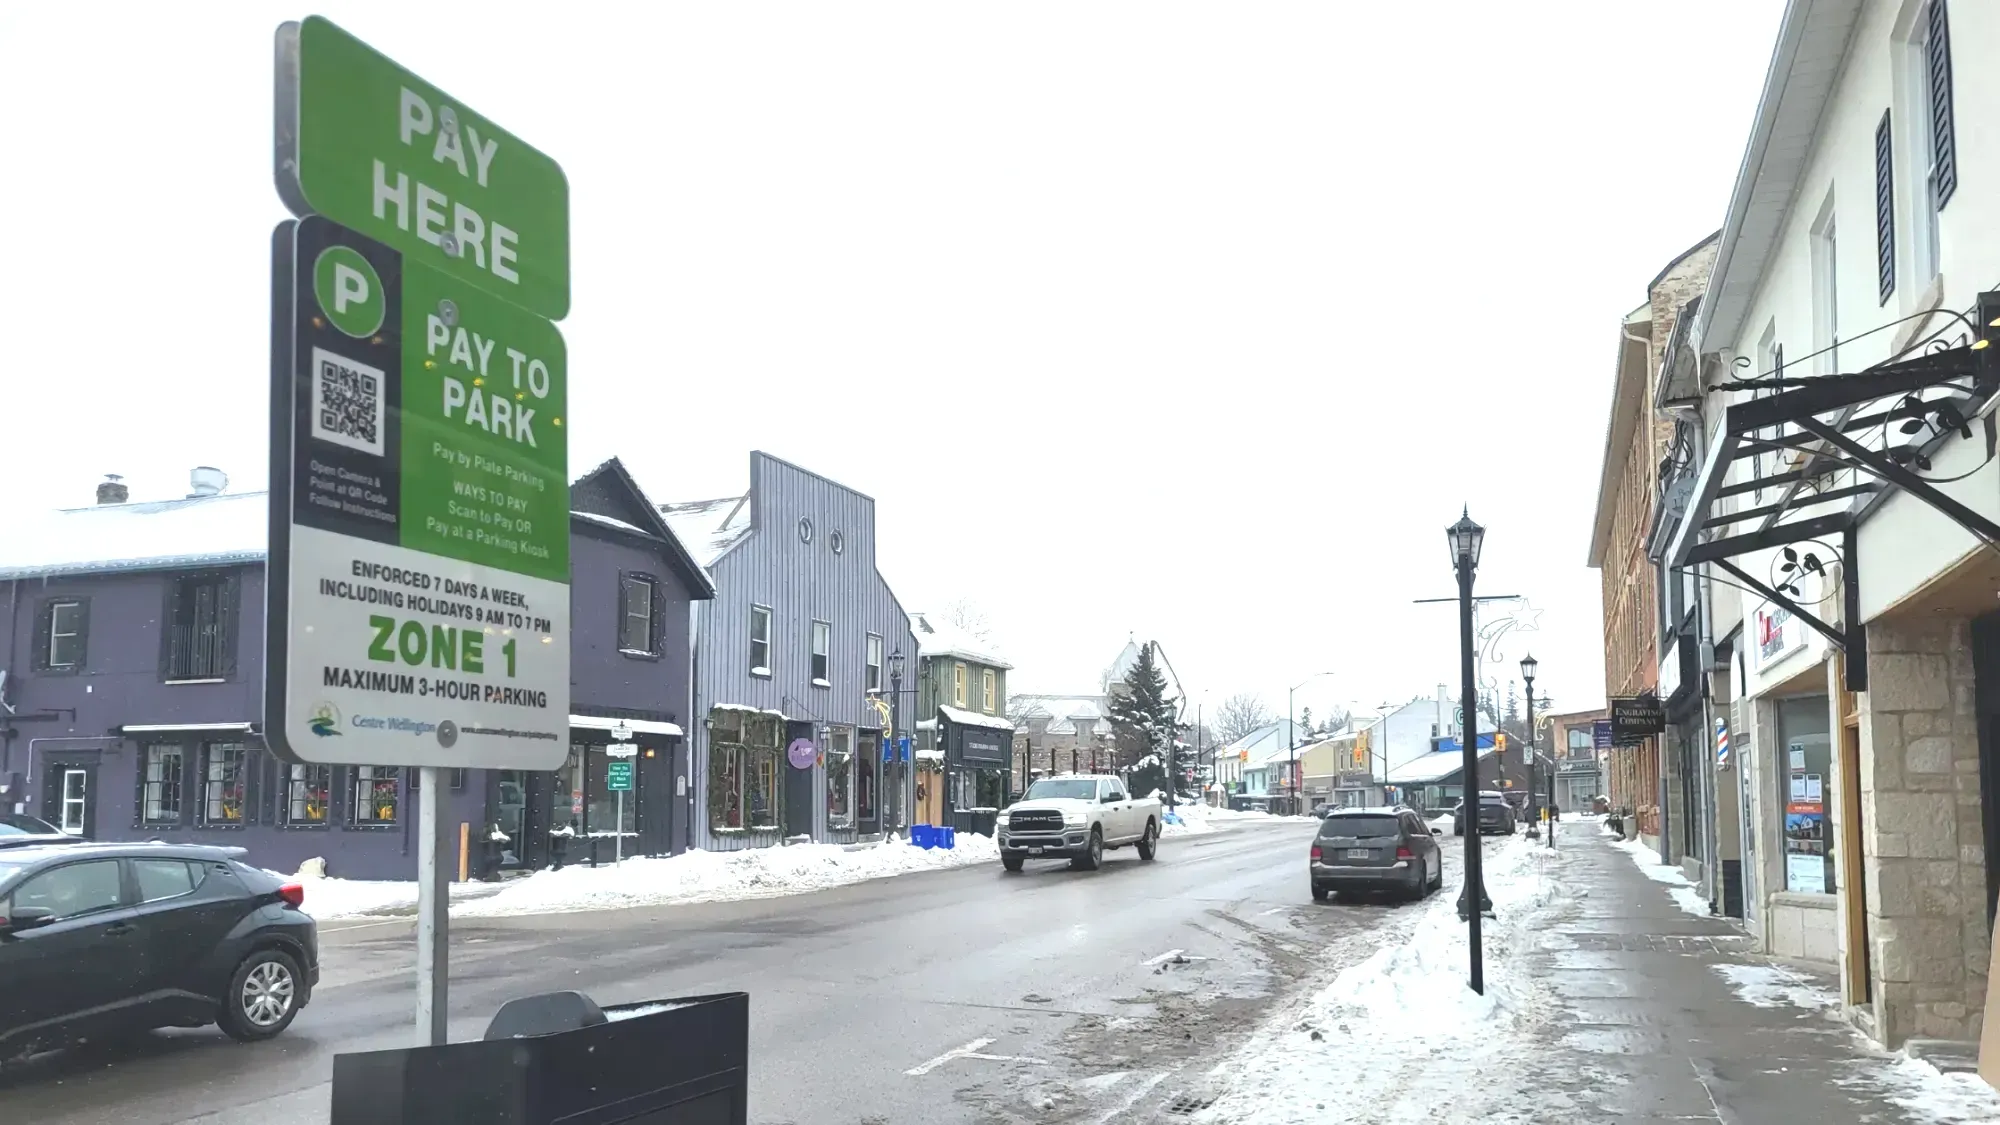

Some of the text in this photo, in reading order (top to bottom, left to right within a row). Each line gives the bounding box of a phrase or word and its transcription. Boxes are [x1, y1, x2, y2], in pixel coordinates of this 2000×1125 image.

[400, 86, 498, 188] PAY
[372, 158, 520, 285] HERE
[334, 262, 369, 314] P
[427, 313, 550, 399] PAY TO
[443, 377, 537, 448] PARK
[310, 459, 335, 481] Open
[338, 466, 373, 486] Camera
[433, 442, 544, 491] Pay by Plate Parking
[309, 476, 388, 506] Point at QR Code
[309, 492, 397, 524] Follow Instructions
[453, 480, 528, 514] WAYS TO PAY
[426, 517, 549, 559] Pay at a Parking Kiosk
[448, 500, 532, 534] Scan to Pay OR
[320, 578, 551, 634] INCLUDING HOLIDAYS 9 AM TO 7 PM
[352, 560, 529, 611] ENFORCED 7 DAYS A WEEK,
[368, 614, 516, 678] ZONE 1
[323, 666, 547, 708] MAXIMUM 3-HOUR PARKING
[351, 714, 437, 736] Centre Wellington
[1619, 716, 1657, 726] COMPANY
